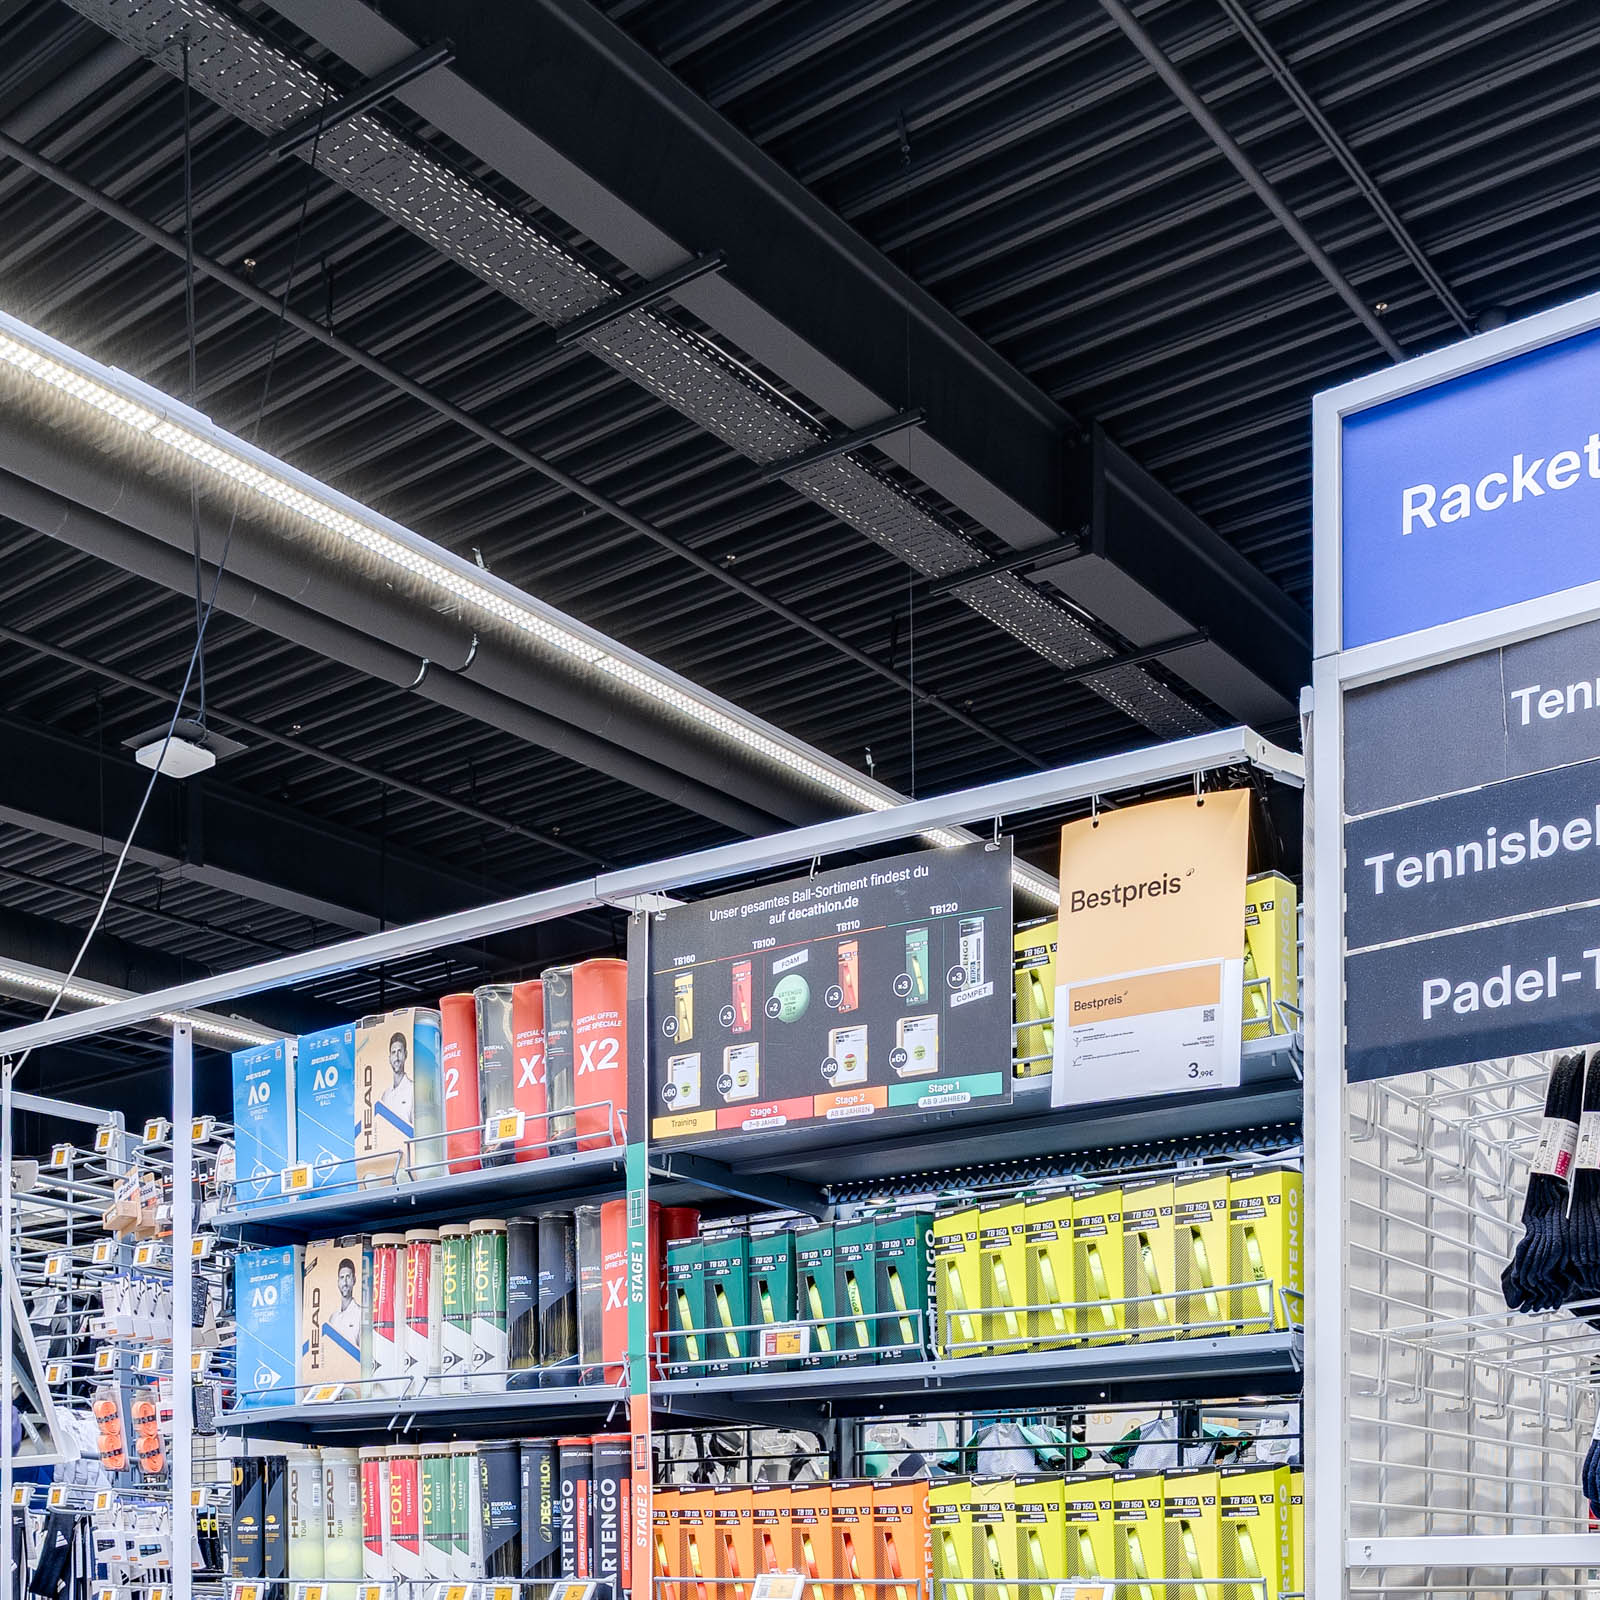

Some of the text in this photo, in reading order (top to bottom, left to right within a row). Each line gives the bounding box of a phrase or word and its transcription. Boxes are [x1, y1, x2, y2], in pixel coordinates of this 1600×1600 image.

[709, 865, 929, 921] Unser gesamtes Ball-Sortiment findest du
[1071, 873, 1181, 913] Bestpreis
[769, 896, 859, 925] auf decathlon.de
[929, 902, 958, 915] TB120
[836, 919, 860, 932] TB110
[752, 937, 776, 949] TB100
[673, 954, 696, 966] TB160
[781, 955, 800, 968] FOAM
[956, 987, 987, 1002] COMPET
[1073, 993, 1123, 1012] Bestpreis
[578, 1037, 620, 1076] X2
[1187, 1062, 1214, 1079] 3,99€
[928, 1081, 960, 1095] Stage 1
[835, 1093, 865, 1106] Stage 2
[939, 1094, 967, 1104] JAHREN
[364, 1065, 373, 1151] HEAD
[750, 1105, 778, 1118] Stage 3
[671, 1118, 698, 1128] Training
[1247, 1198, 1261, 1207] 160
[1269, 1196, 1280, 1204] X3
[906, 1238, 915, 1247] X3
[475, 1249, 489, 1304] FORT
[632, 1251, 643, 1303] STAGE
[311, 1287, 321, 1369] HEAD
[540, 1455, 551, 1525] DECATHLON
[291, 1469, 299, 1538] HEAD
[390, 1473, 402, 1525] FORT
[636, 1483, 648, 1548] STAGE 2
